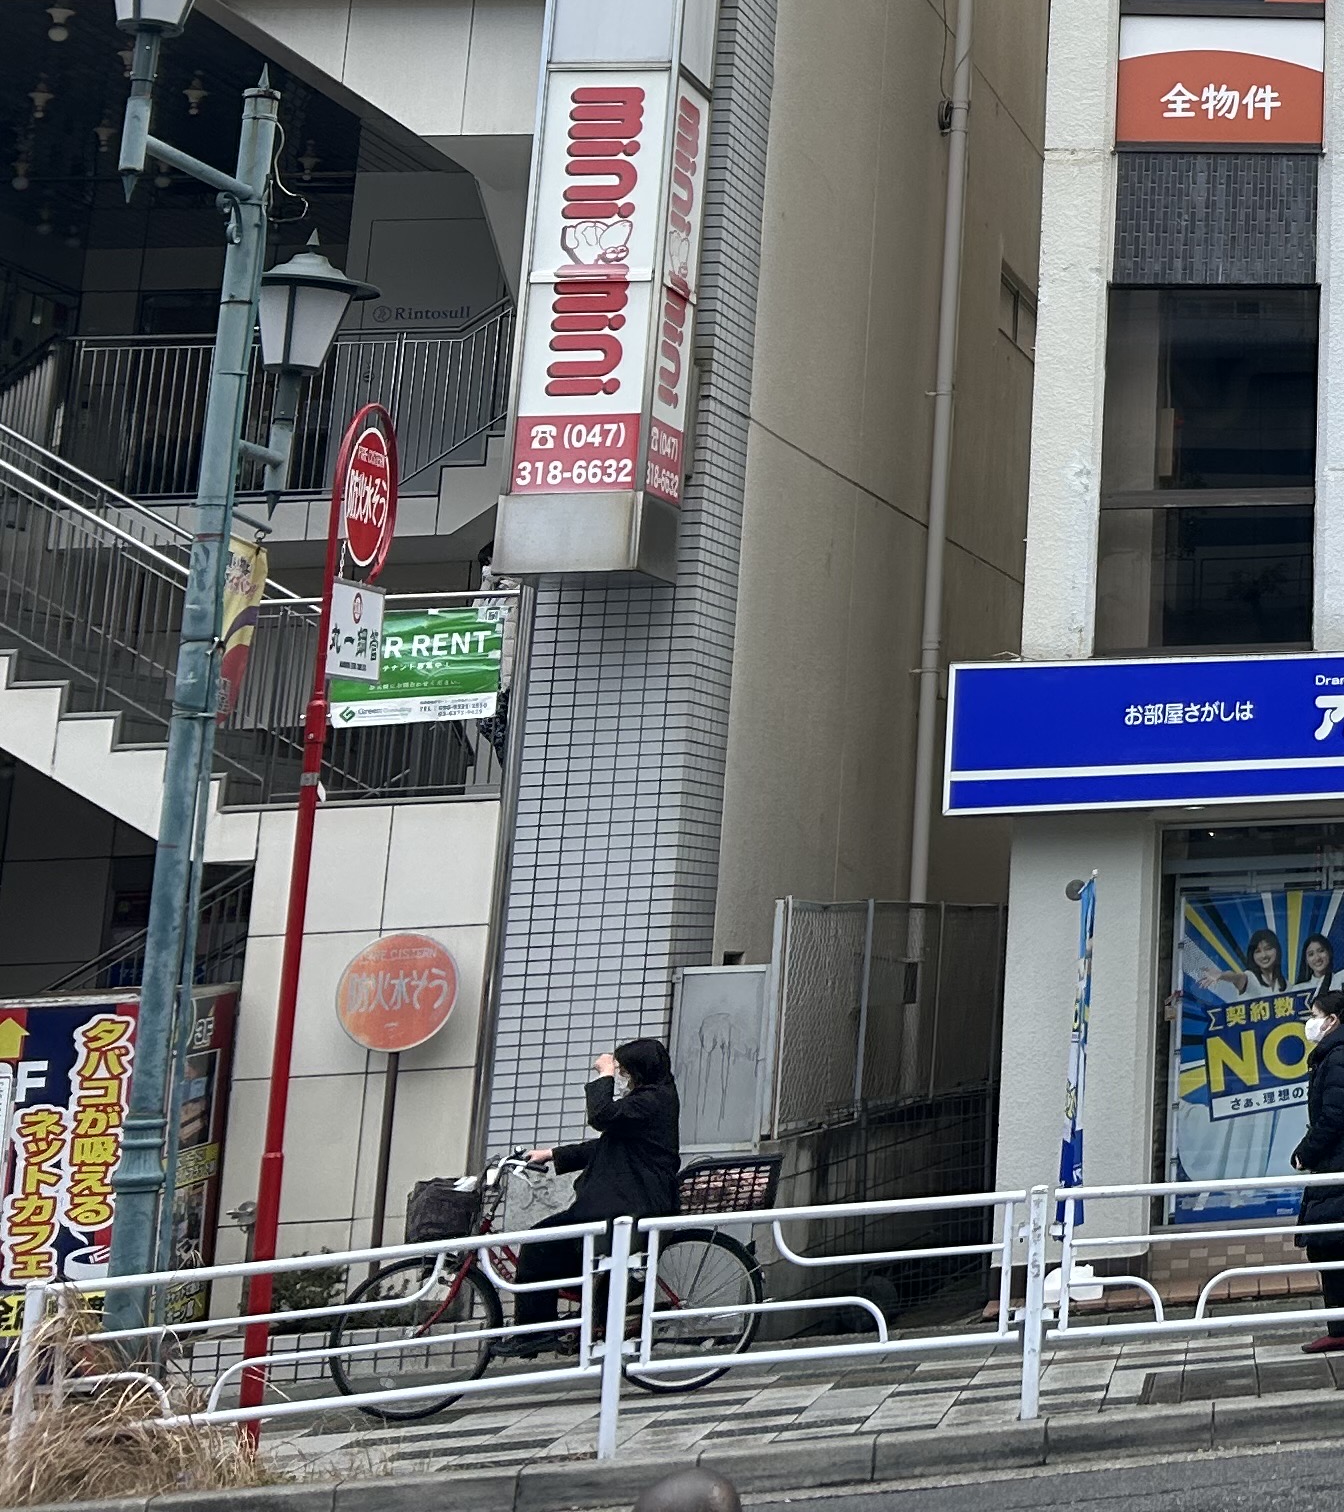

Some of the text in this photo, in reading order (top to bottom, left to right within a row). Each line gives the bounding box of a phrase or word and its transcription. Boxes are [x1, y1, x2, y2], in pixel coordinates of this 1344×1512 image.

[1159, 82, 1282, 120] 全物件
[394, 305, 471, 321] Rintosull
[562, 422, 626, 449] (047)
[515, 458, 634, 486] 318-6632
[346, 468, 388, 529] 防火水そう
[411, 630, 492, 657] RENT
[1124, 700, 1255, 727] お部屋さがしは
[347, 967, 449, 1015] 防火水そう
[1226, 996, 1296, 1026] 契約数
[66, 1017, 131, 1226] タバコが吸える
[9, 1108, 68, 1280] ネットカフェ
